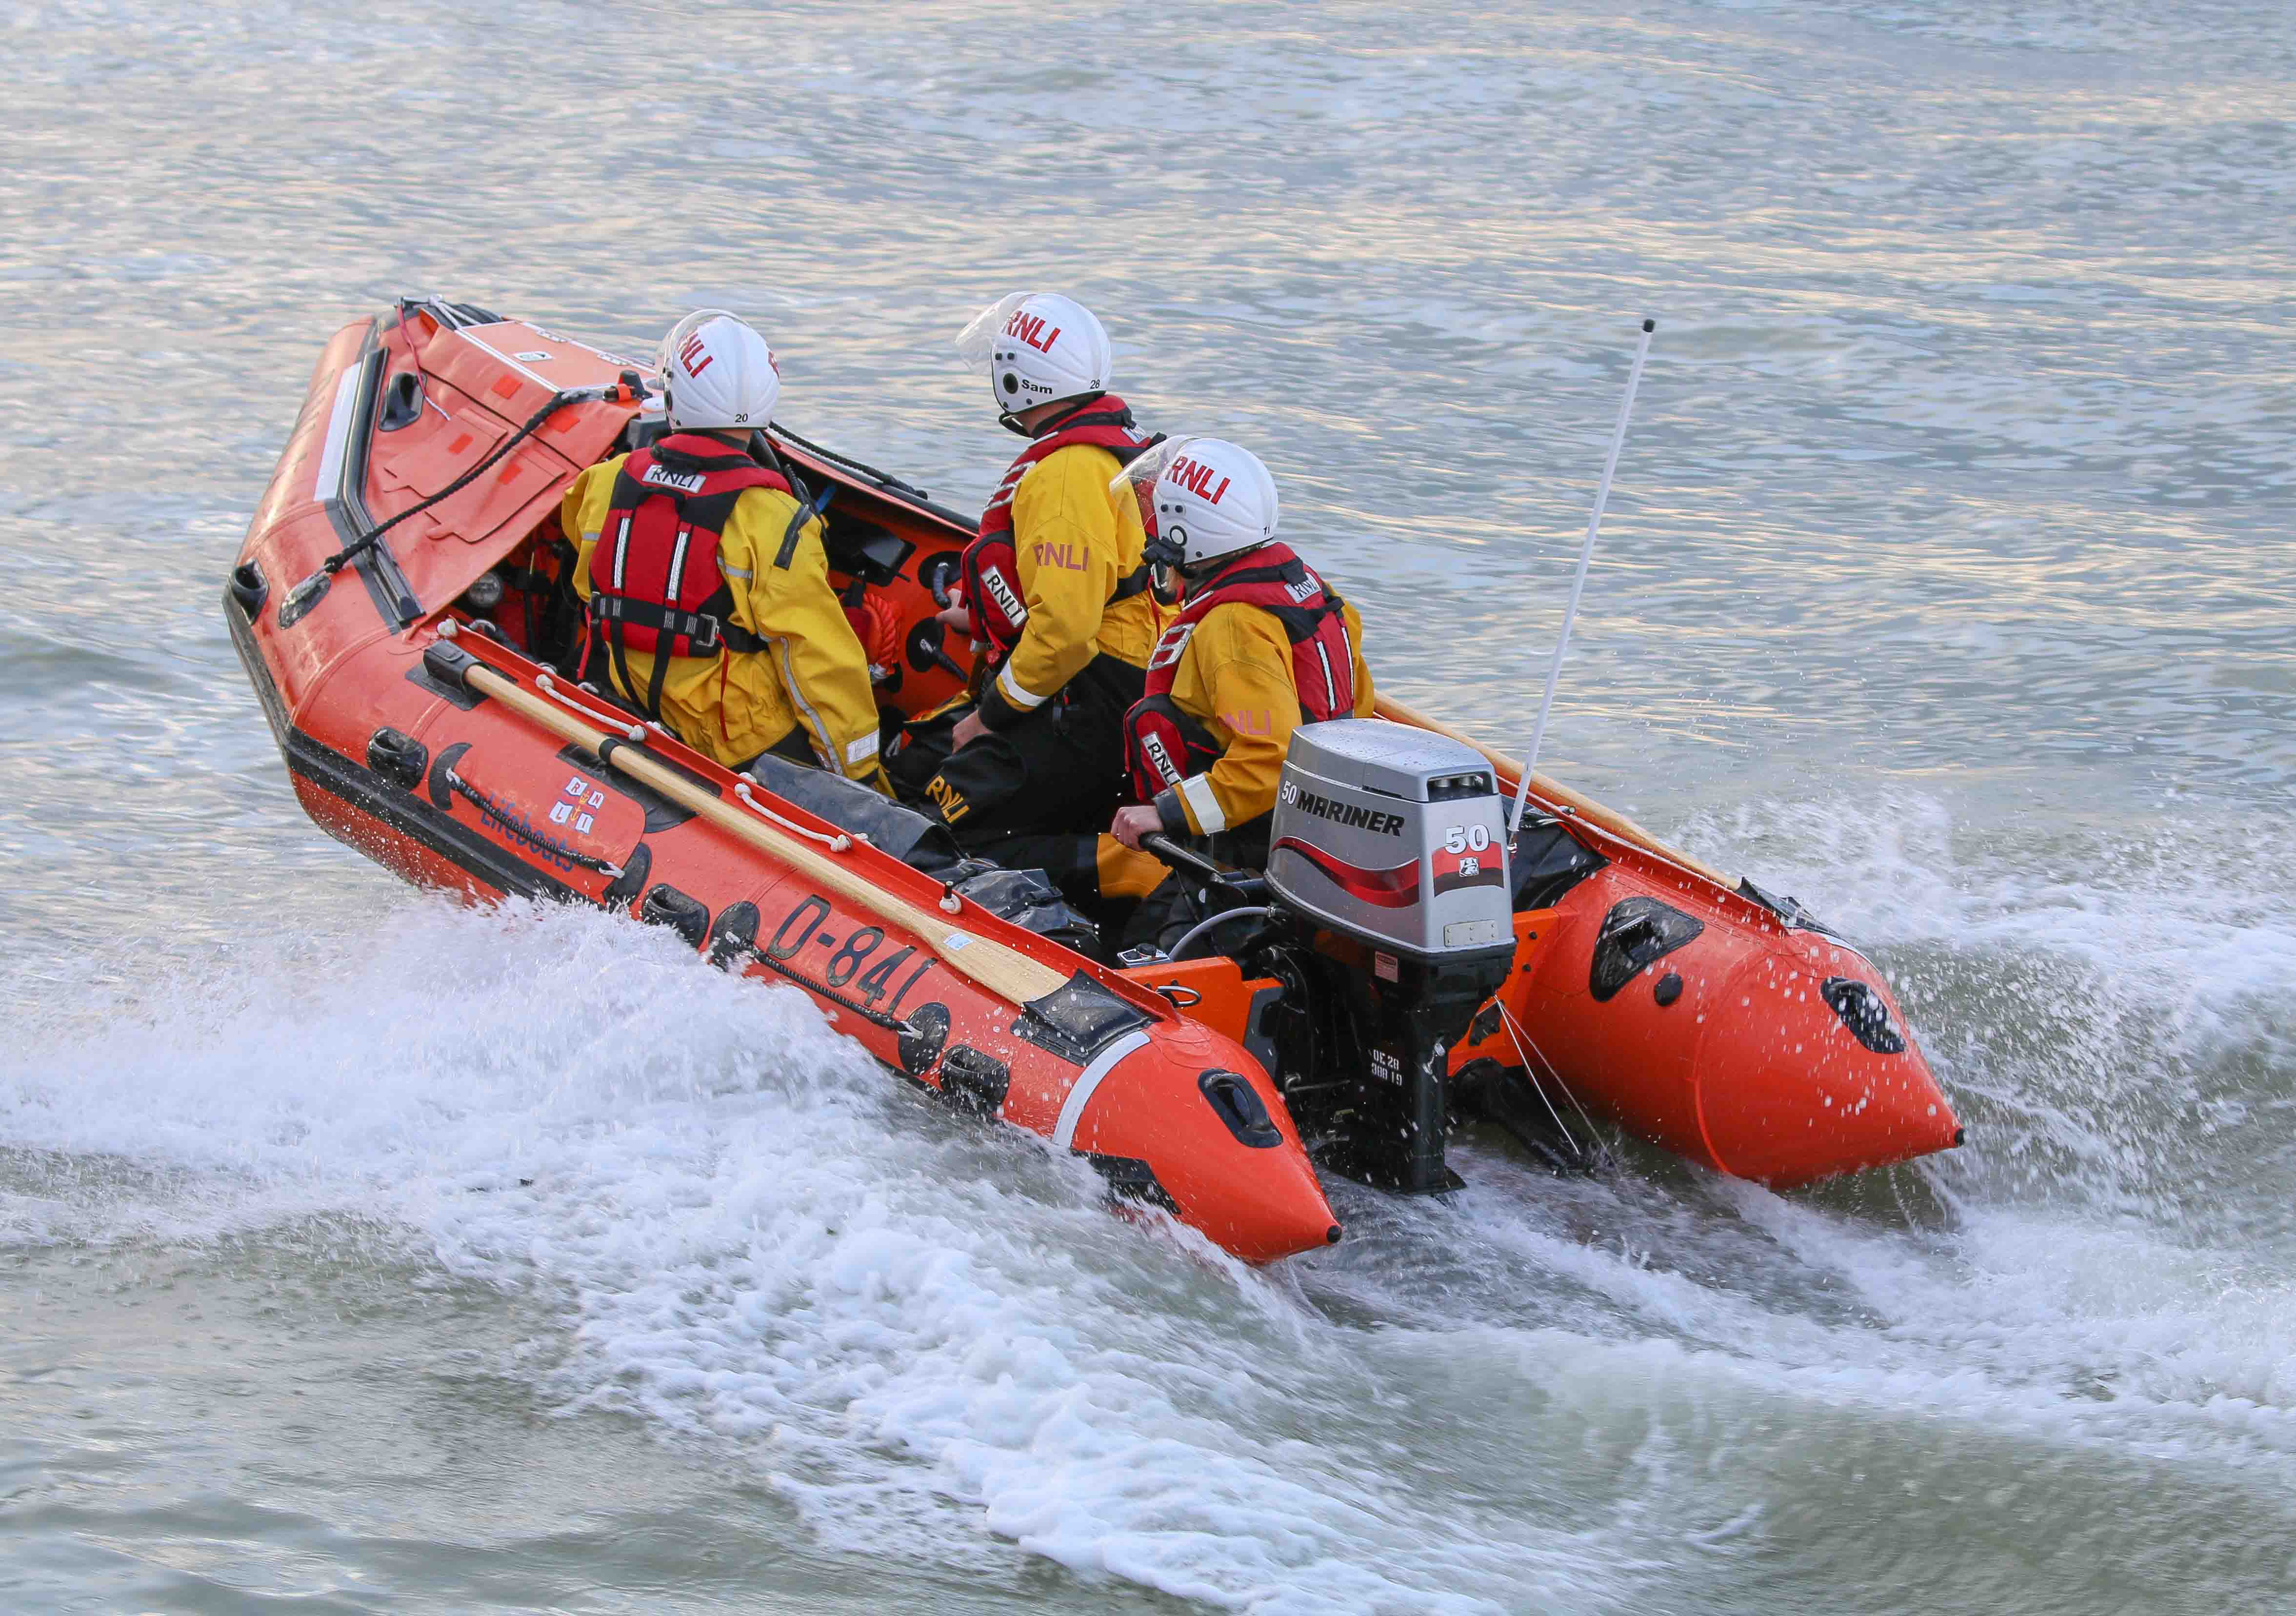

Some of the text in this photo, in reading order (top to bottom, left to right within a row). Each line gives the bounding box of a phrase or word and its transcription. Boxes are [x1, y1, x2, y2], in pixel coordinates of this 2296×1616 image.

[1001, 311, 1061, 354] RNLI
[1021, 379, 1053, 394] Sam
[1090, 379, 1100, 389] 28
[735, 413, 748, 423] 20
[651, 467, 697, 488] RNLI
[1164, 456, 1231, 505] RNLI
[986, 574, 1023, 619] RNLI
[1147, 742, 1180, 786] RNLI
[925, 775, 969, 823] RNLI
[1281, 780, 1405, 837] 50 MARINER
[1444, 824, 1490, 854] 50
